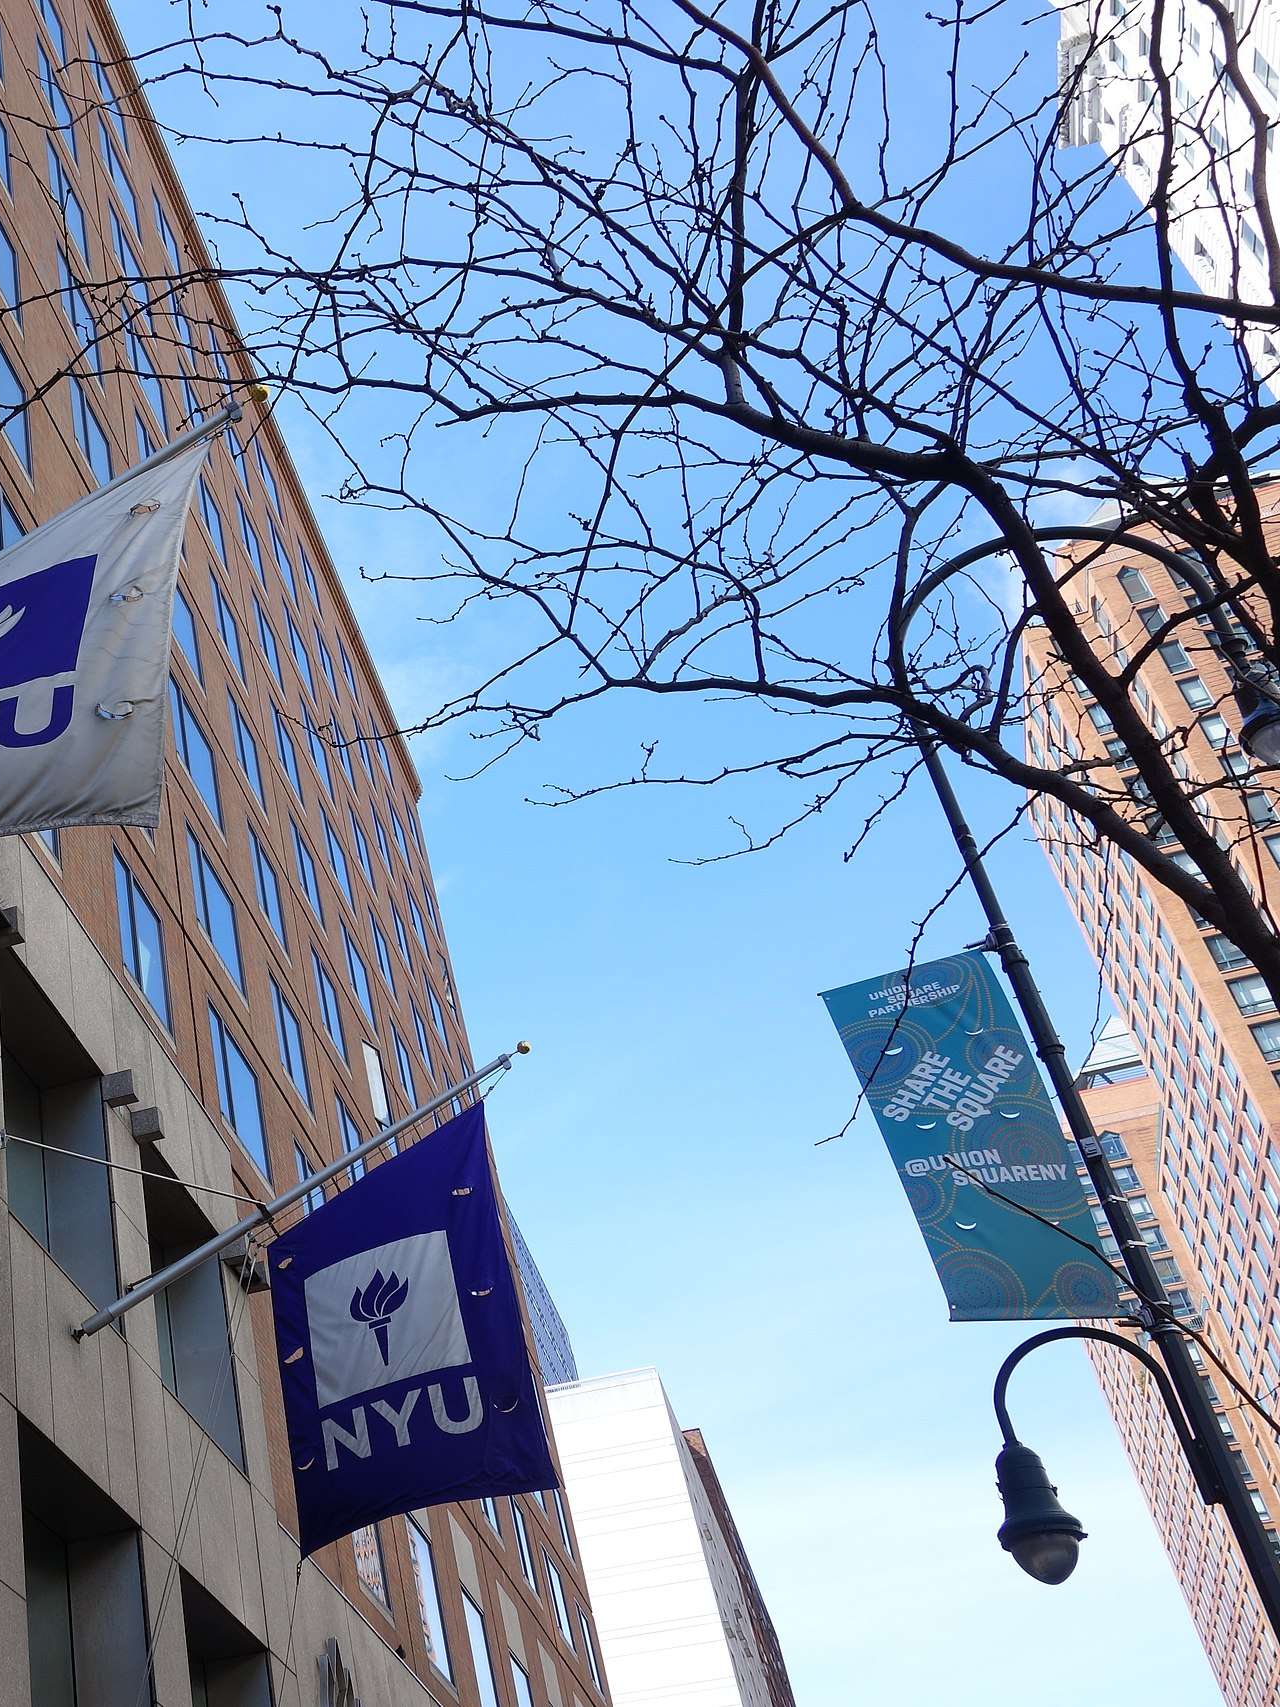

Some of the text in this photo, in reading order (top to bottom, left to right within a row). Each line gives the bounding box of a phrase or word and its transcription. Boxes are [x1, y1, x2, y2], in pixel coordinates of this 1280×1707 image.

[868, 983, 913, 1001] UNION
[868, 984, 961, 1018] PARTNERSHIP
[882, 1050, 951, 1122] SHARE
[921, 1067, 972, 1111] THE
[946, 1044, 1024, 1132] SQUARE
[904, 1149, 1002, 1177] @UNION
[951, 1163, 1068, 1187] SQUARENY
[321, 1376, 484, 1472] NYU
